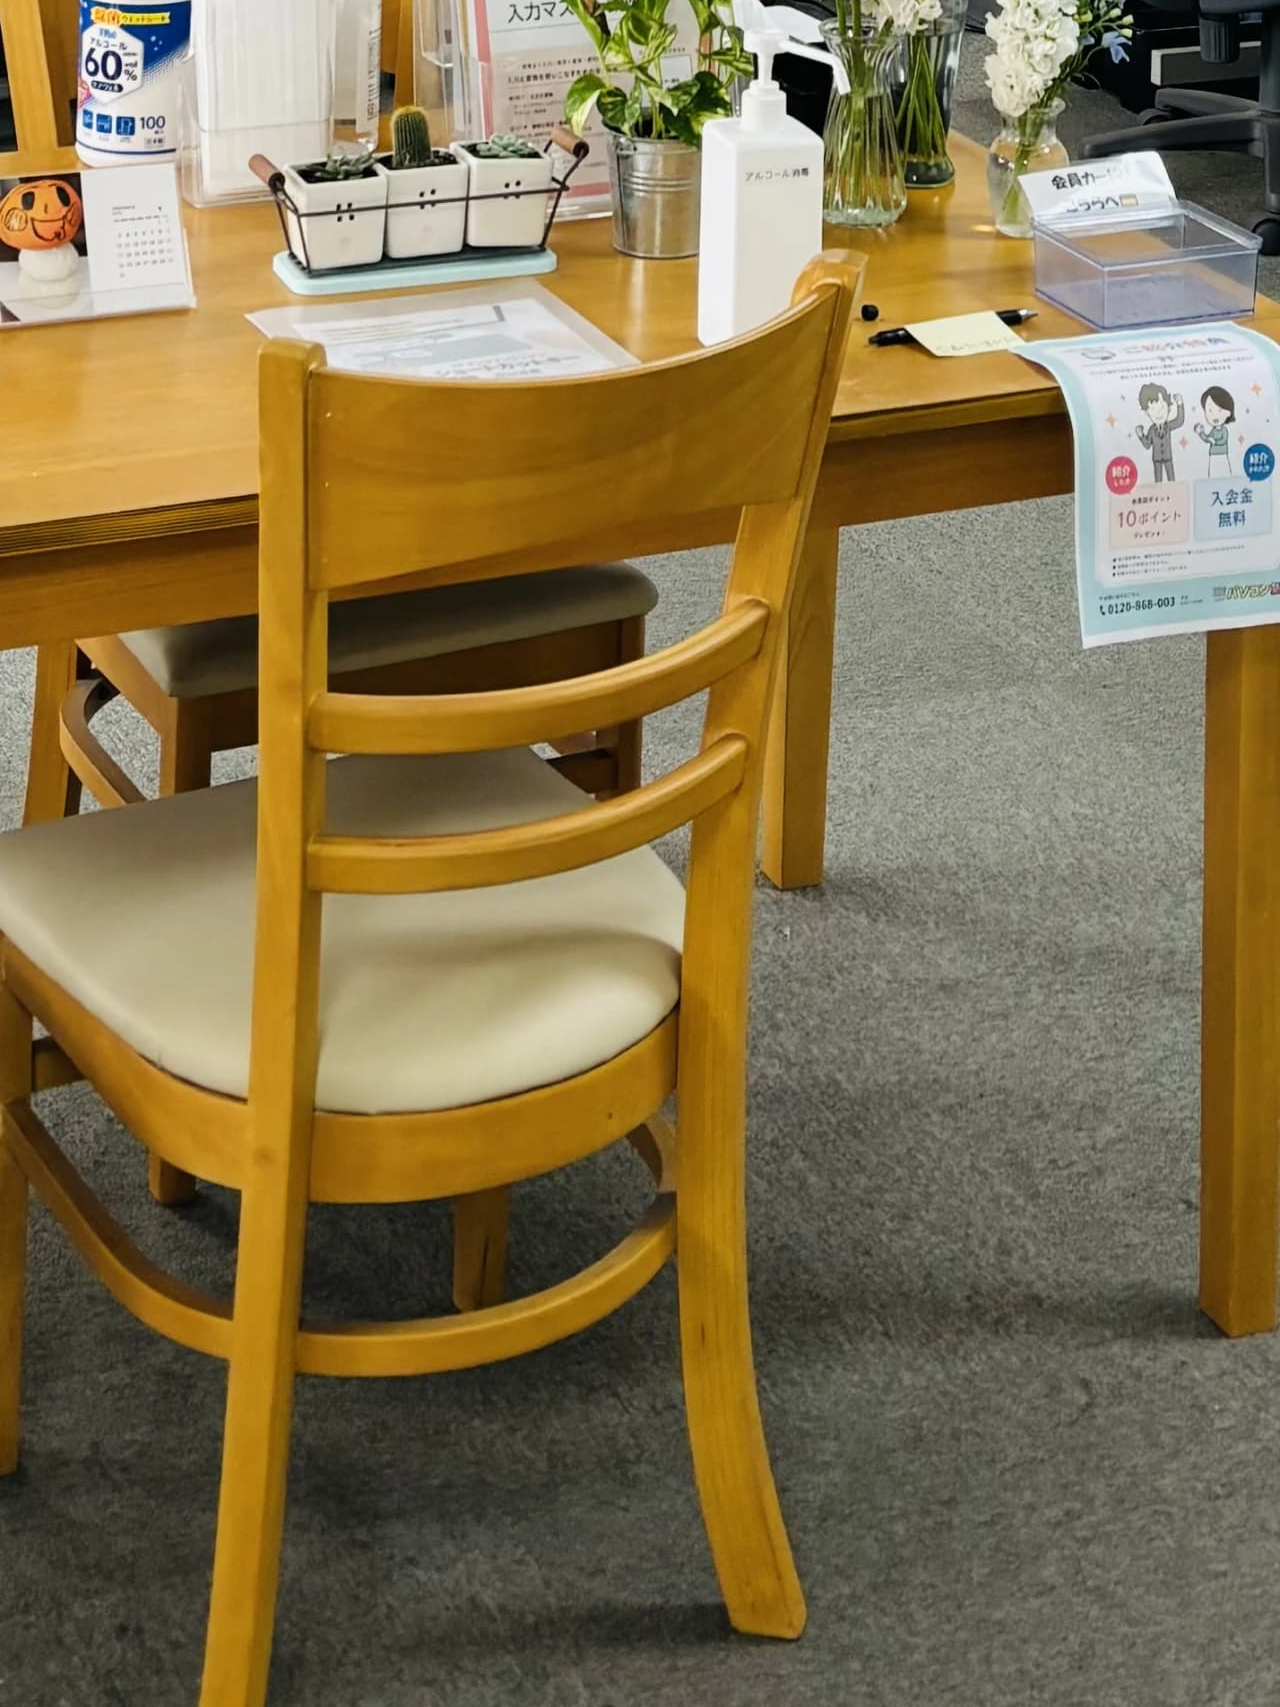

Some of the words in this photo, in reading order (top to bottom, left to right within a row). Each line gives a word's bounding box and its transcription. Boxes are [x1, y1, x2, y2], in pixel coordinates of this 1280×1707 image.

[89, 37, 128, 51] アルコール
[85, 48, 123, 81] 60
[140, 115, 166, 130] 100
[745, 167, 810, 182] アルコール消毒
[1210, 487, 1253, 508] 入会金
[1218, 509, 1246, 529] 無料
